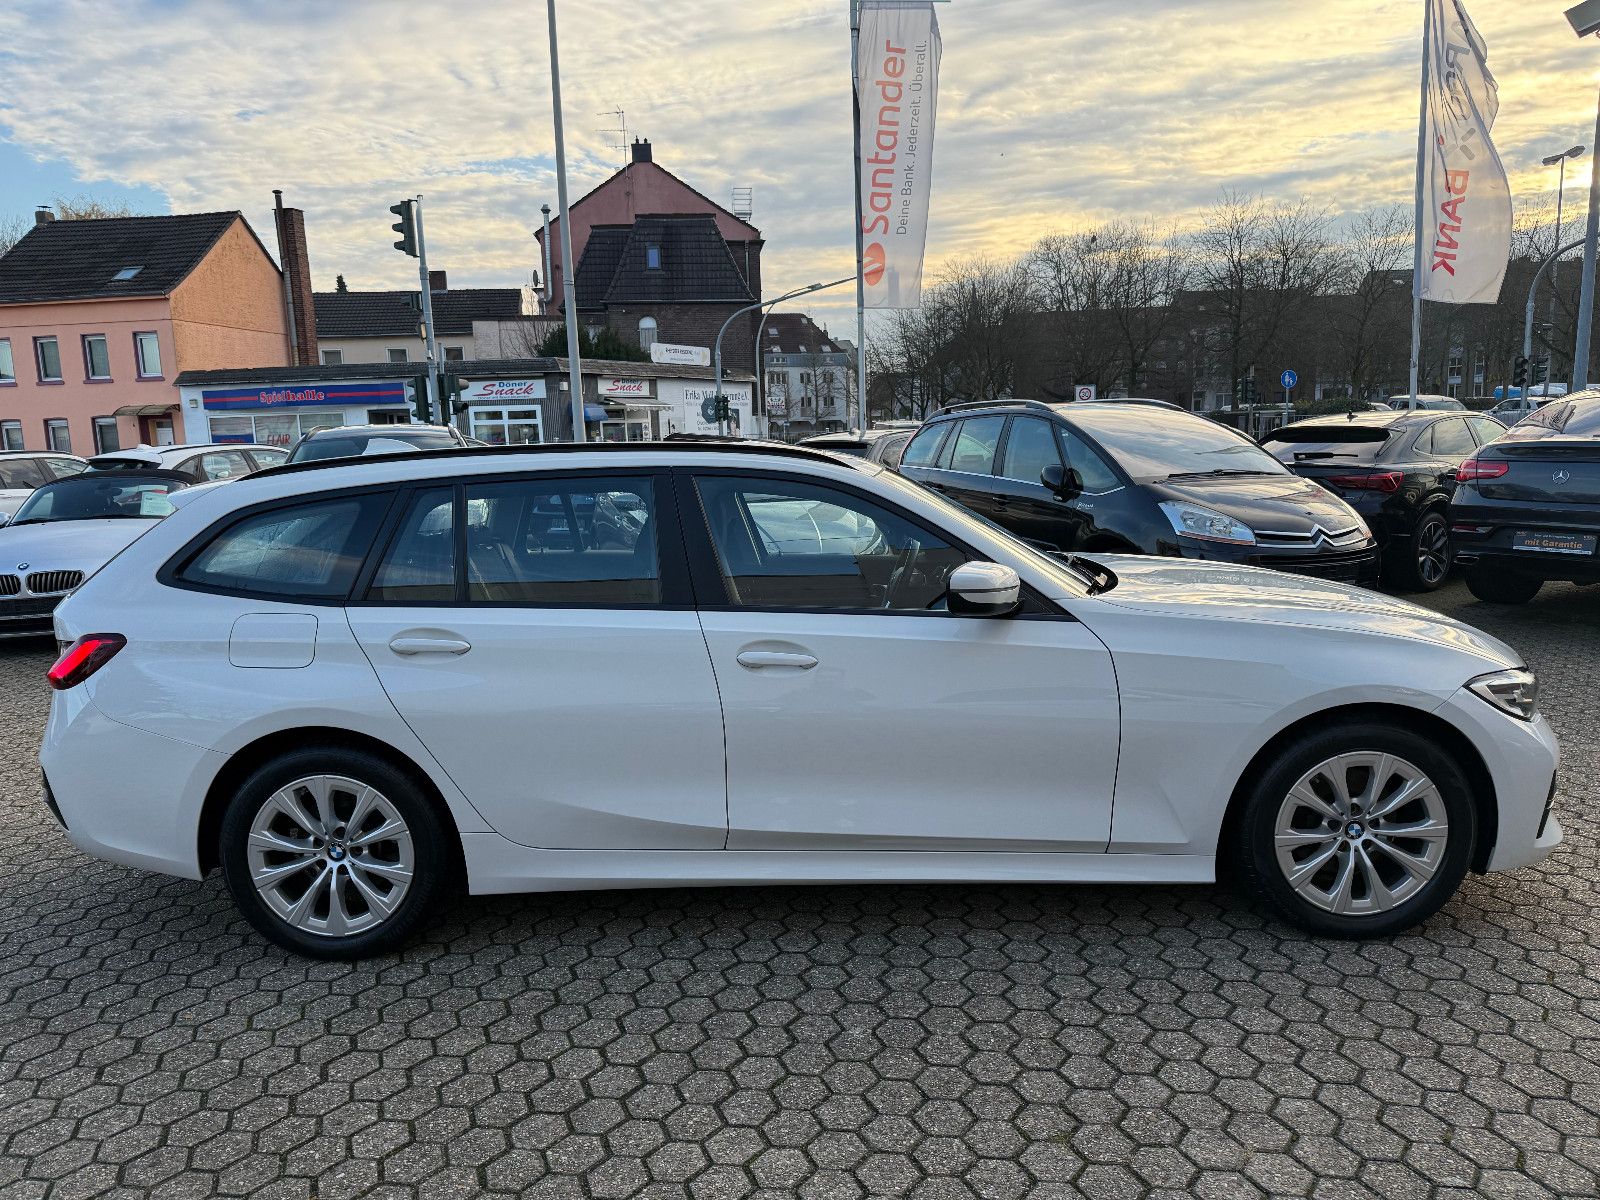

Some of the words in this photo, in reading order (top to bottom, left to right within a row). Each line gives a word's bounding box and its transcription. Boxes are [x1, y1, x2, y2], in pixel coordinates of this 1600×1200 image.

[909, 40, 927, 92] Überall.
[861, 40, 907, 236] Santander
[905, 96, 922, 157] Jederzeit.
[901, 161, 915, 196] Bank.
[896, 199, 911, 235] Deine
[260, 388, 325, 404] Spielhalle
[472, 383, 535, 397] Snack
[606, 379, 643, 392] Snack
[267, 433, 291, 446] FLAIR
[1524, 538, 1540, 547] mit
[1542, 539, 1584, 550] Garantie
